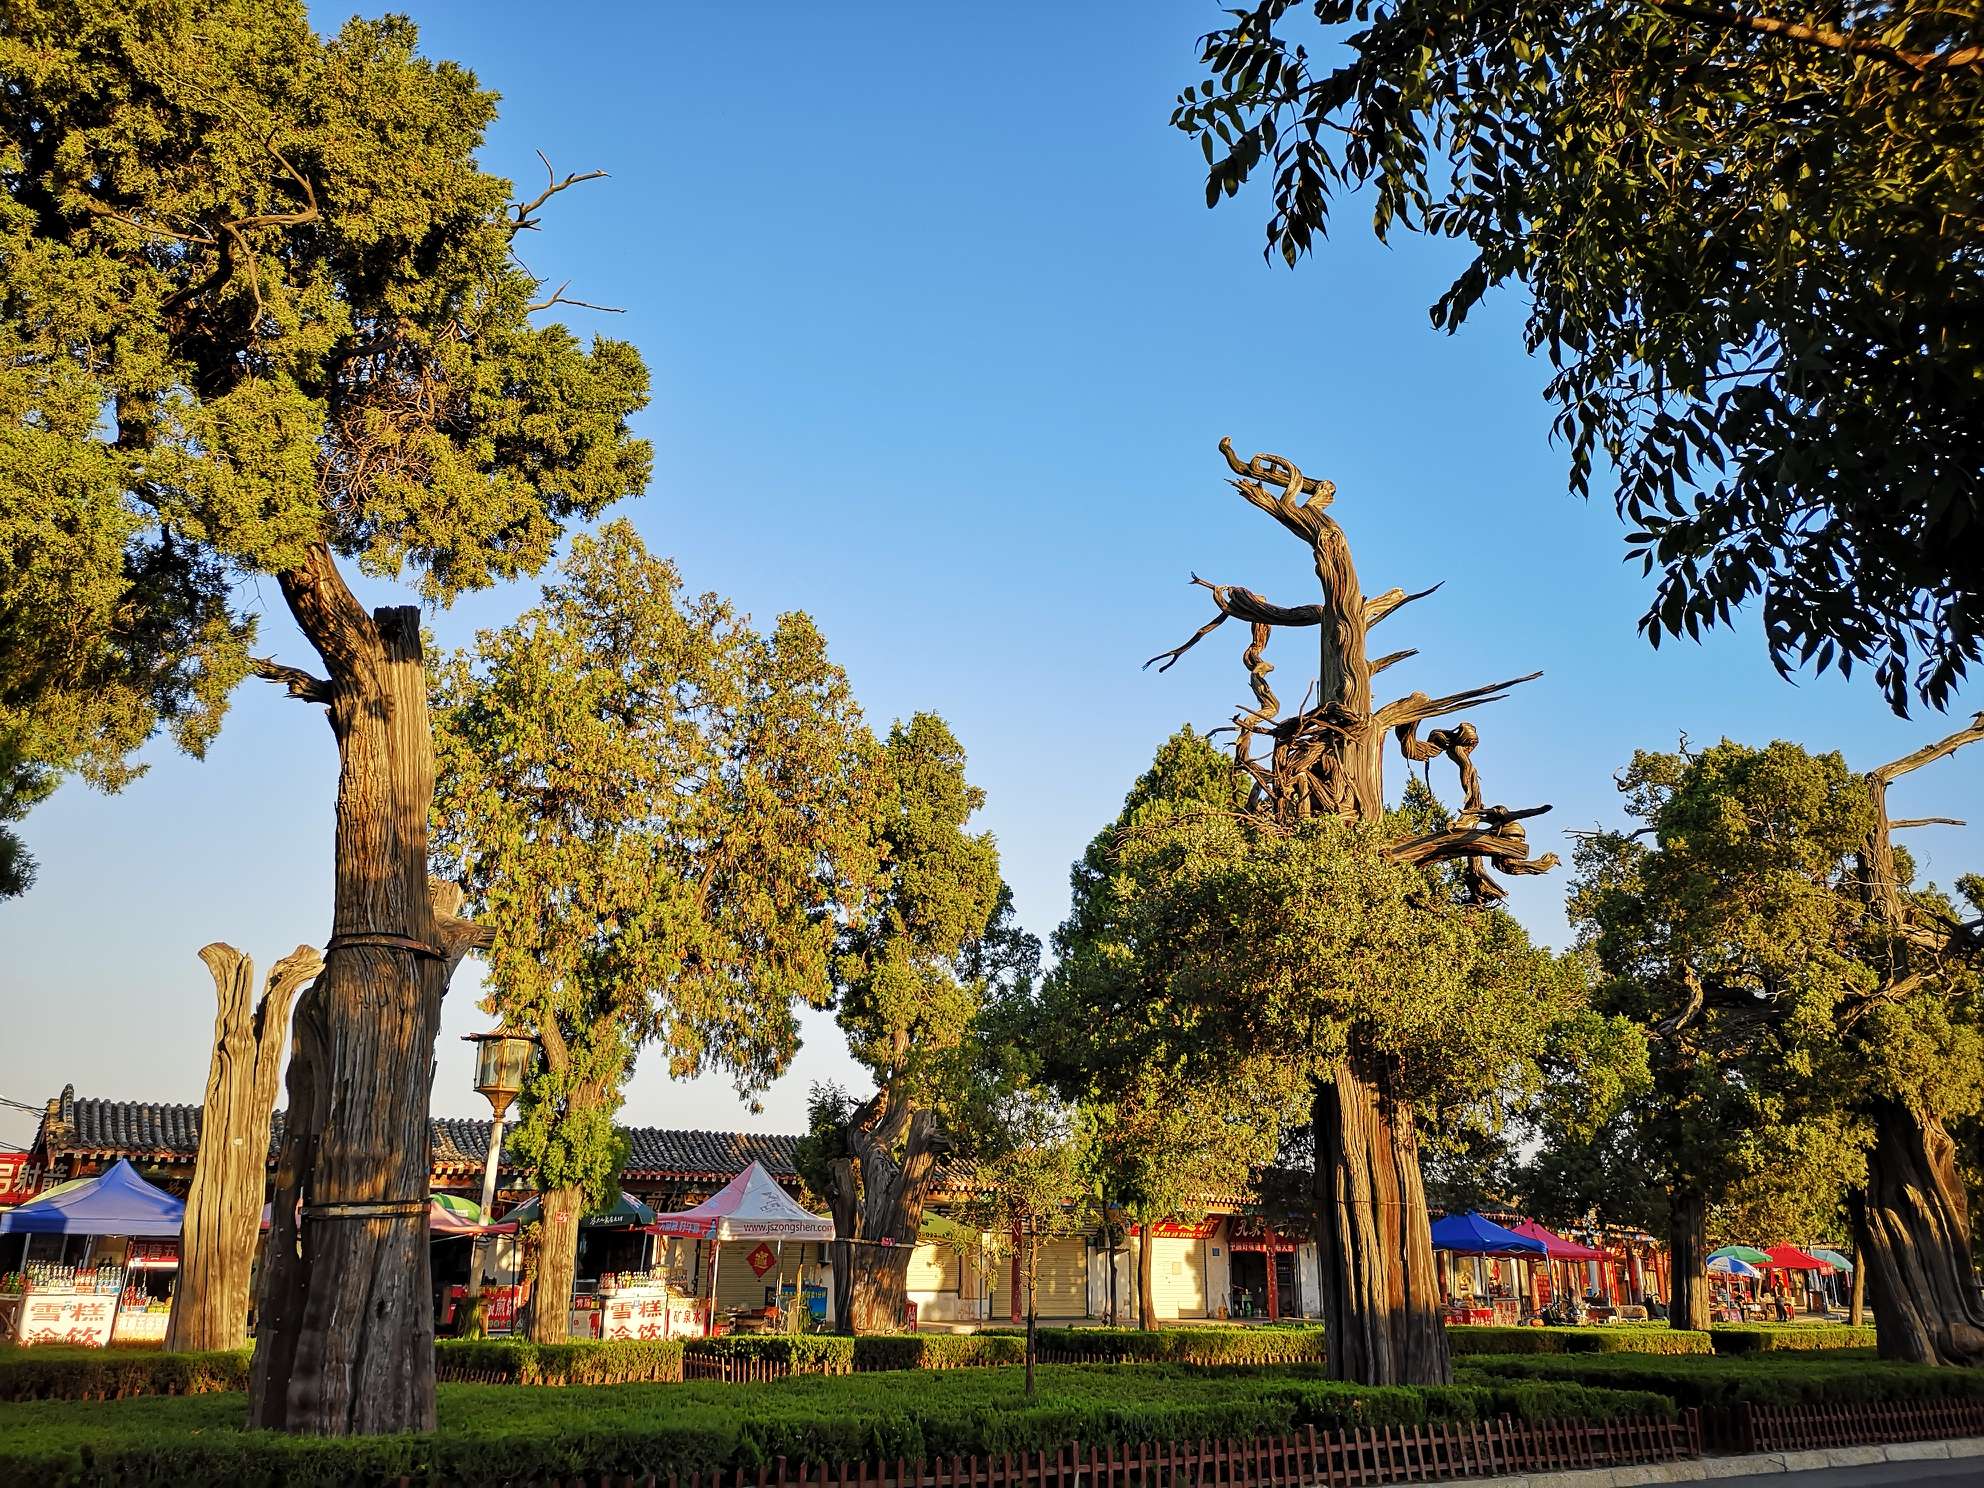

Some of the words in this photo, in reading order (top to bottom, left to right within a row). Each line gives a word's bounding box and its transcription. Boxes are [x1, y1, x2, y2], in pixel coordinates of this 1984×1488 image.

[744, 1222, 834, 1234] www.jszongshen.com
[31, 1302, 107, 1322] 雪糕
[611, 1300, 662, 1320] 雪糕
[673, 1309, 702, 1324] 矿泉水
